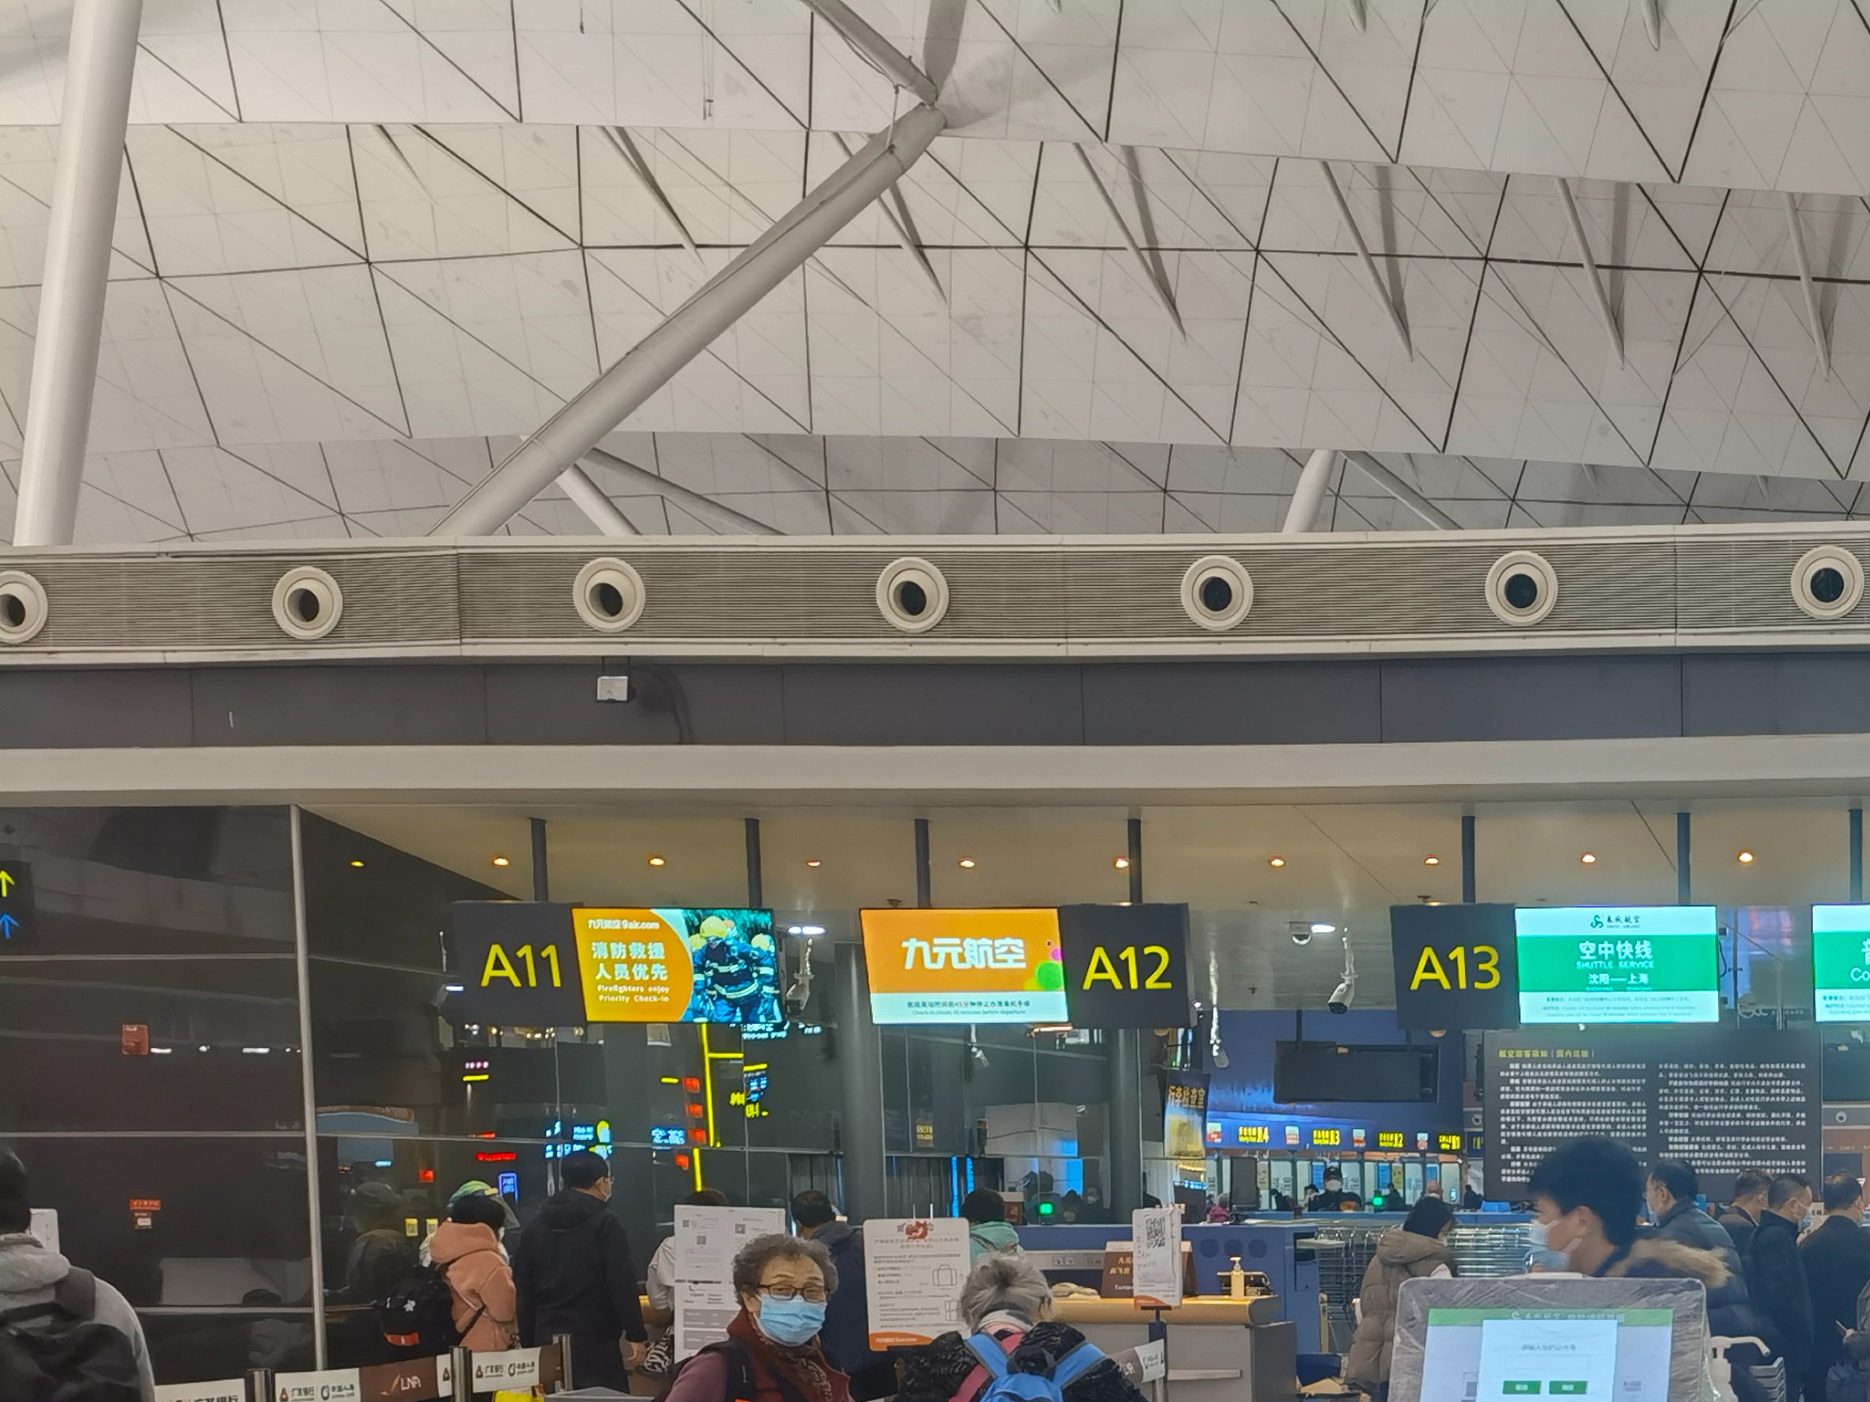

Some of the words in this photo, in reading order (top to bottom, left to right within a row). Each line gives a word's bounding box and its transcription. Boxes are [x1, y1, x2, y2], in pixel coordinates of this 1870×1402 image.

[592, 942, 665, 960] 消防救援
[902, 938, 1027, 970] 九元航空
[1578, 940, 1654, 960] 空中快线
[481, 944, 562, 988] A11
[595, 963, 668, 981] 人员优先
[1083, 945, 1172, 990] A12
[1410, 946, 1500, 991] A13
[1576, 961, 1614, 970] SHUTTLE
[1618, 960, 1655, 970] SERVICE
